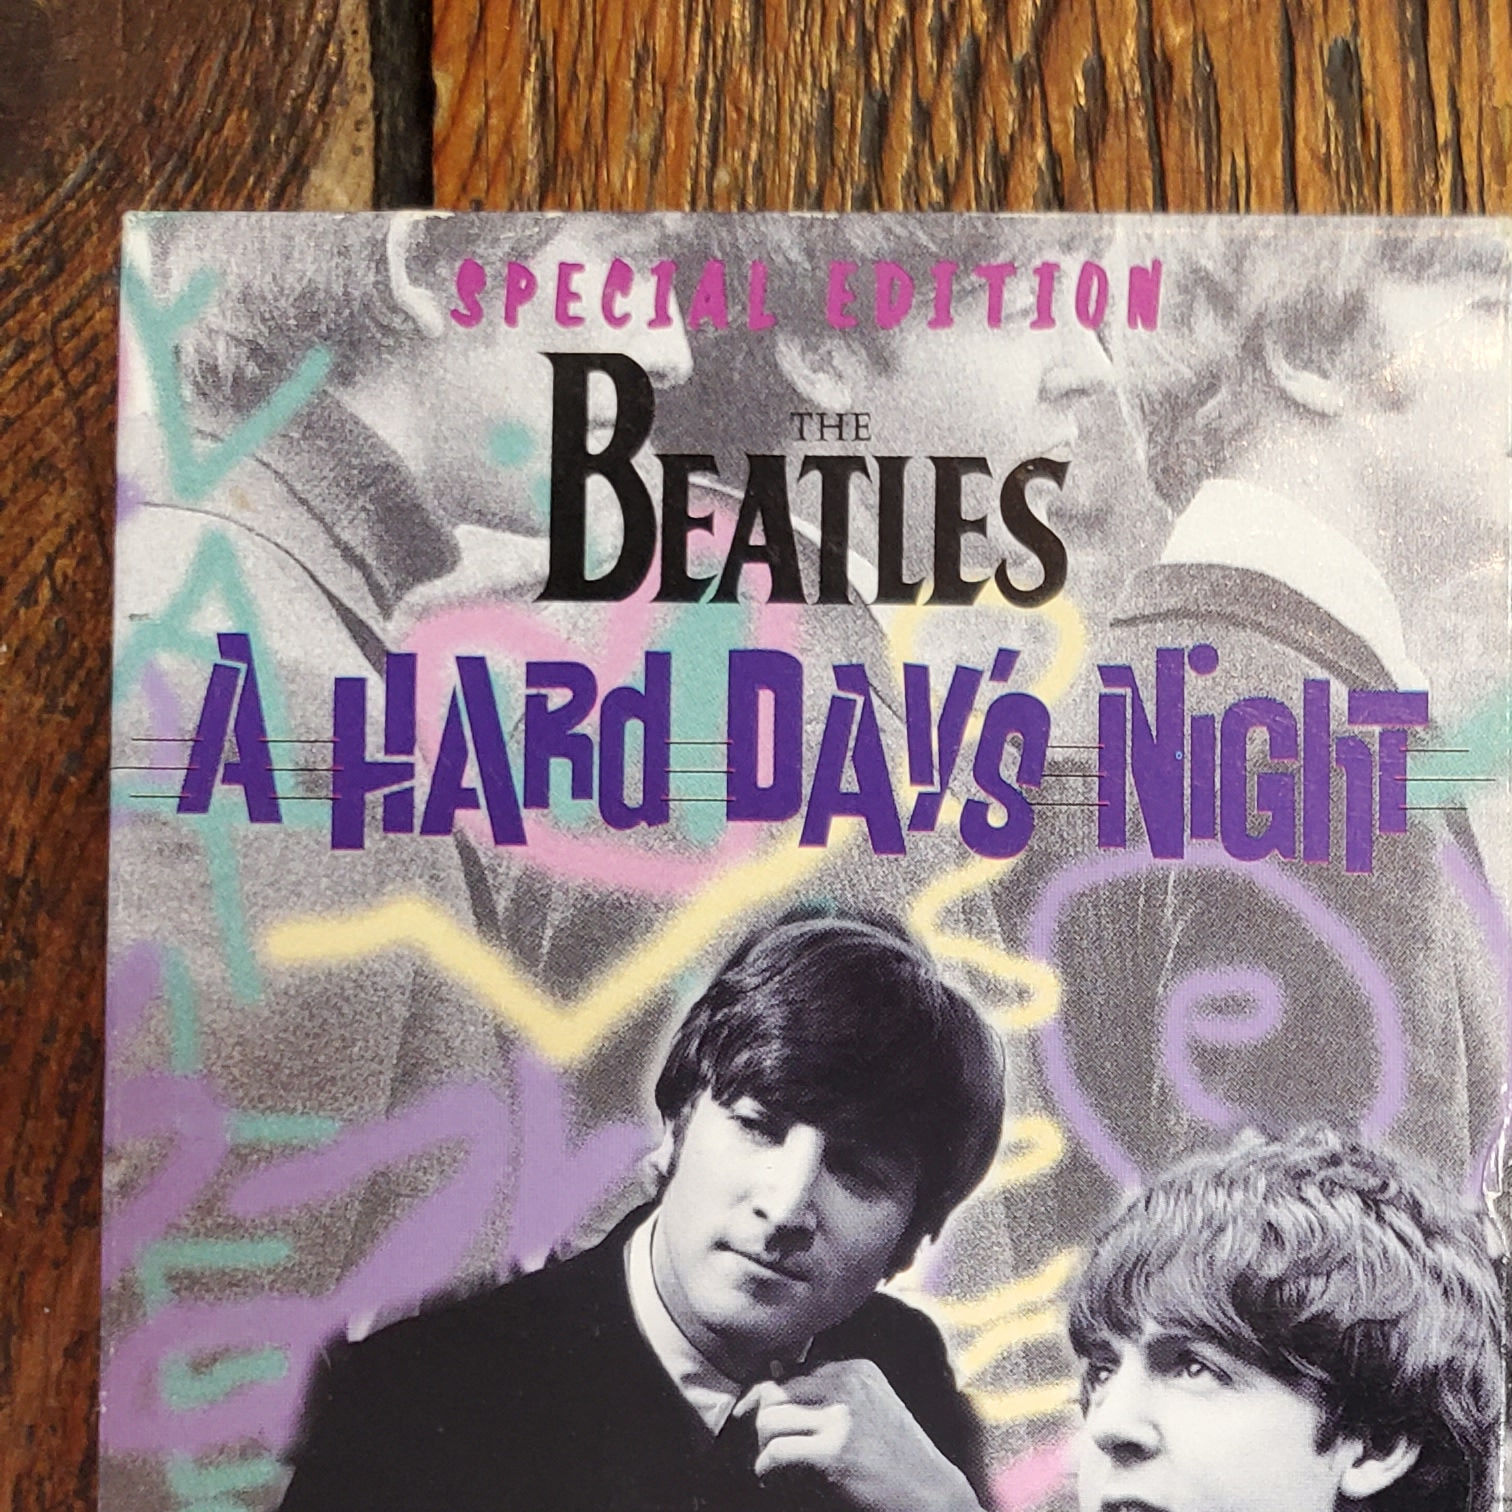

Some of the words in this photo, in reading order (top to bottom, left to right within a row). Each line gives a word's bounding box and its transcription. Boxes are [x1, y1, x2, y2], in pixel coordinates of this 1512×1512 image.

[450, 257, 775, 331] SPECIAL
[825, 257, 1162, 332] EDITION
[536, 352, 1072, 608] BEATLES
[790, 411, 871, 442] THE
[176, 632, 283, 824] A
